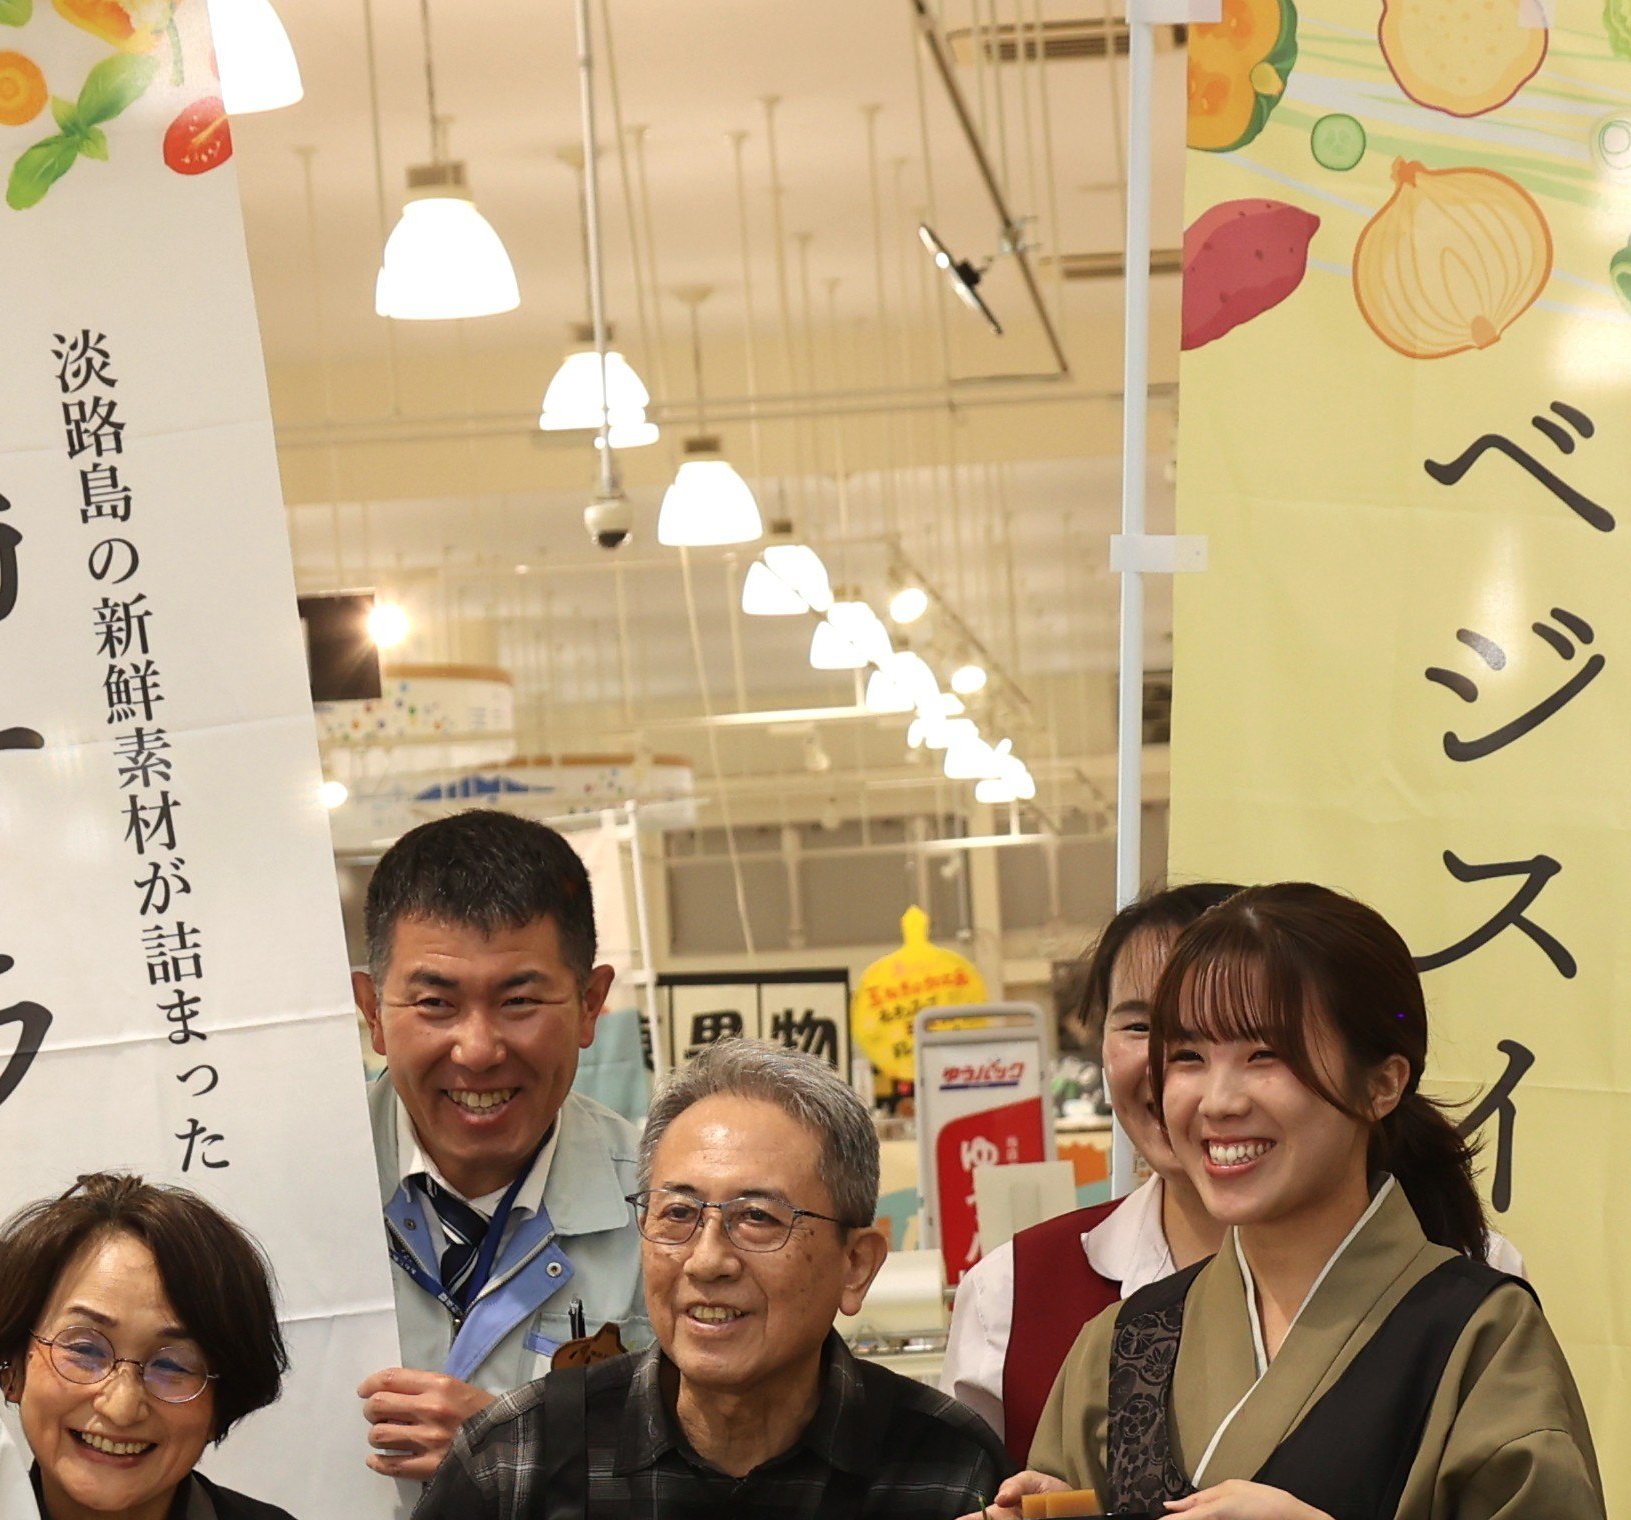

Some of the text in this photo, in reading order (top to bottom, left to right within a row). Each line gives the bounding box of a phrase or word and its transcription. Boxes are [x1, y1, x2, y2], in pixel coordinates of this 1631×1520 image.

[50, 328, 231, 1174] 淡路島の新鮮素材が詰まった
[942, 1062, 1026, 1083] ゆうパック
[1414, 400, 1616, 1213] ベジスイ
